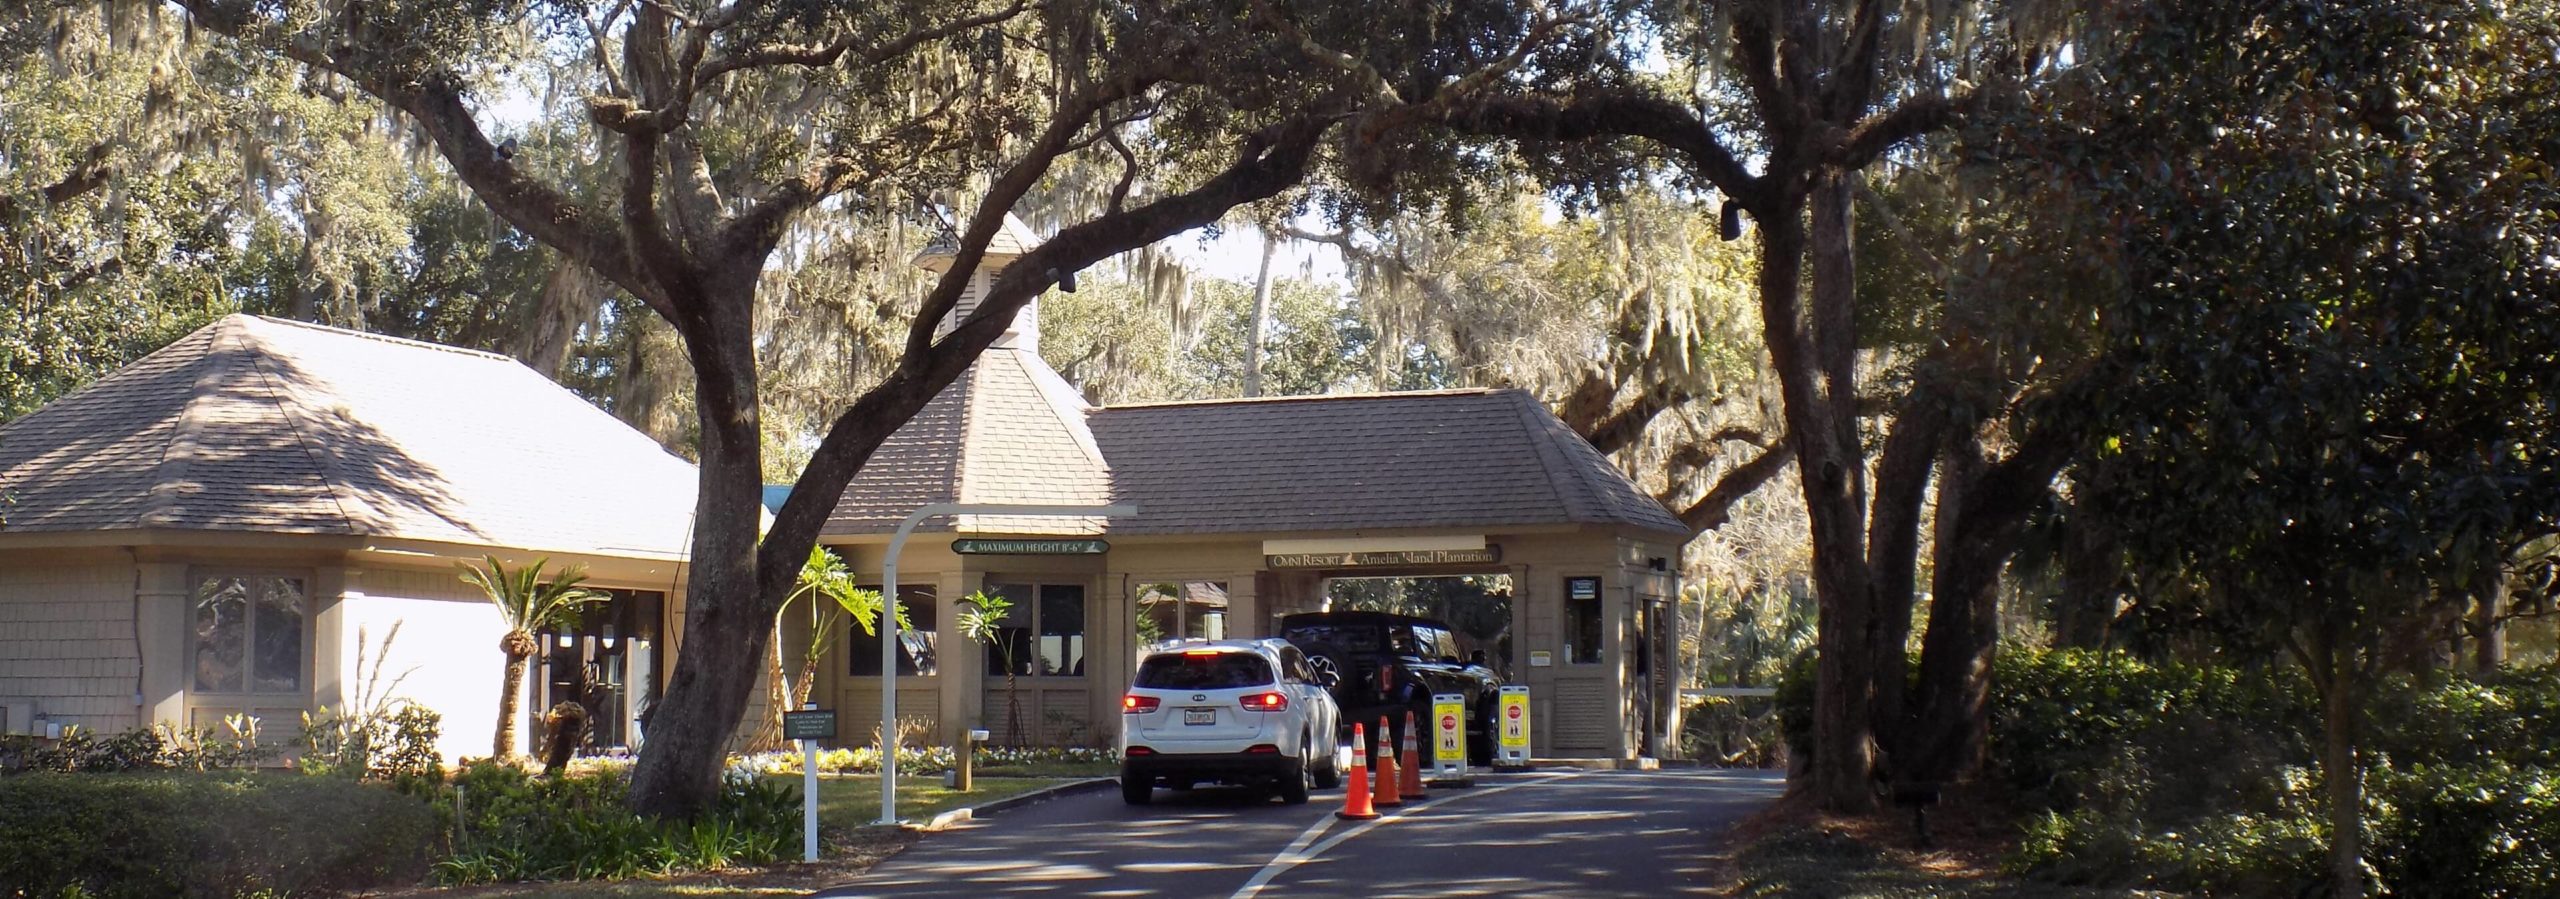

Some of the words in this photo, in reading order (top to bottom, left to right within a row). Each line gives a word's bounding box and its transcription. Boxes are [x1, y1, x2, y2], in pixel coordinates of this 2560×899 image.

[978, 543, 1024, 553] MAXIMUM
[1026, 543, 1061, 553] HEIGHT
[1273, 555, 1300, 567] OMNI
[1303, 554, 1340, 566] RESORT
[1360, 553, 1399, 565] Amelia
[1402, 551, 1434, 564] sland
[1437, 550, 1493, 563] Plantation
